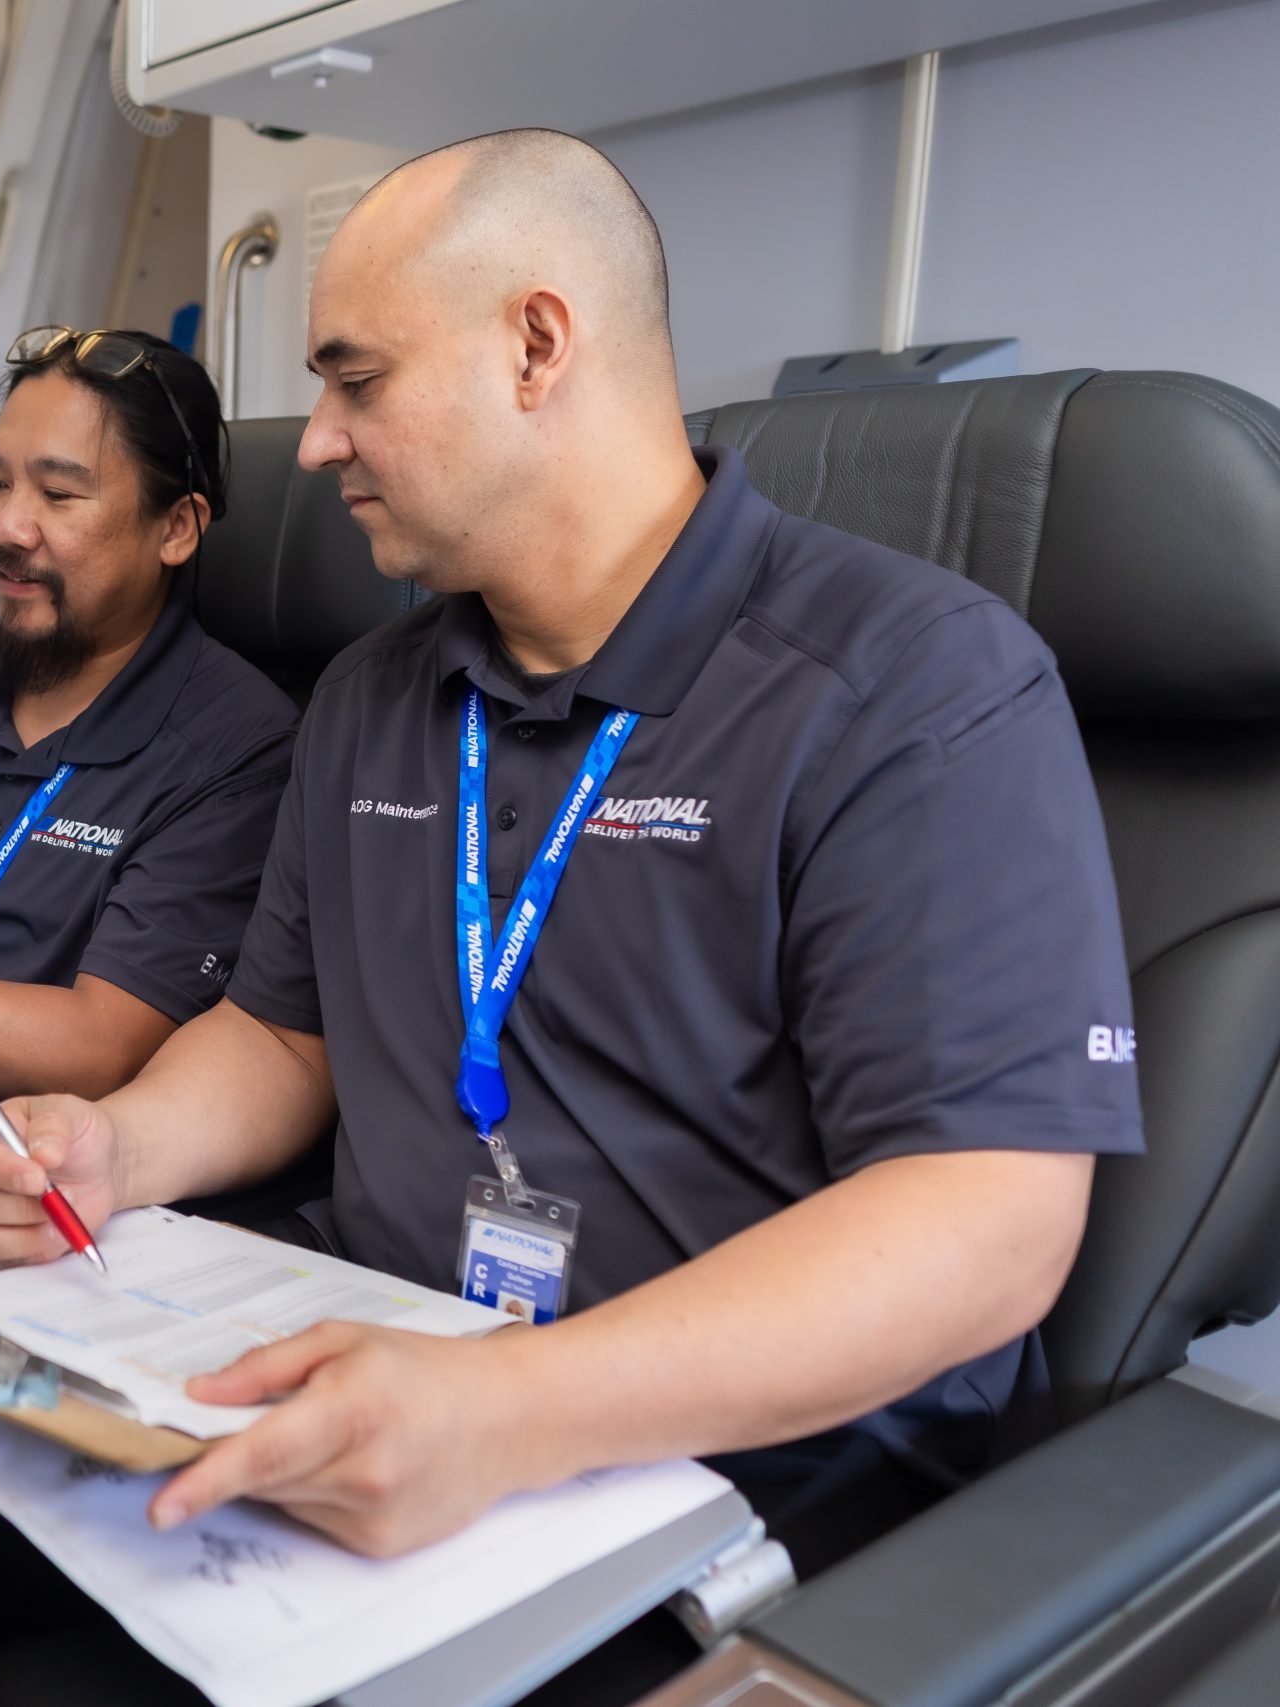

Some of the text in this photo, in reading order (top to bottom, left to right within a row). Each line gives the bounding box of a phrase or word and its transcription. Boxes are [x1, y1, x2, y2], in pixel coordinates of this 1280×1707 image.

[467, 691, 478, 755] NATIONAL
[43, 763, 71, 795] TIONAL
[350, 799, 373, 814] AOG
[544, 786, 588, 863] NATIONAL
[31, 833, 114, 857] WE DELIVER THE WOR
[465, 802, 478, 871] NATIONAL
[651, 826, 701, 842] WORLD
[467, 921, 484, 994] NATIONAL
[491, 914, 530, 993] NATIONAL
[495, 1231, 554, 1256] NATIONAL
